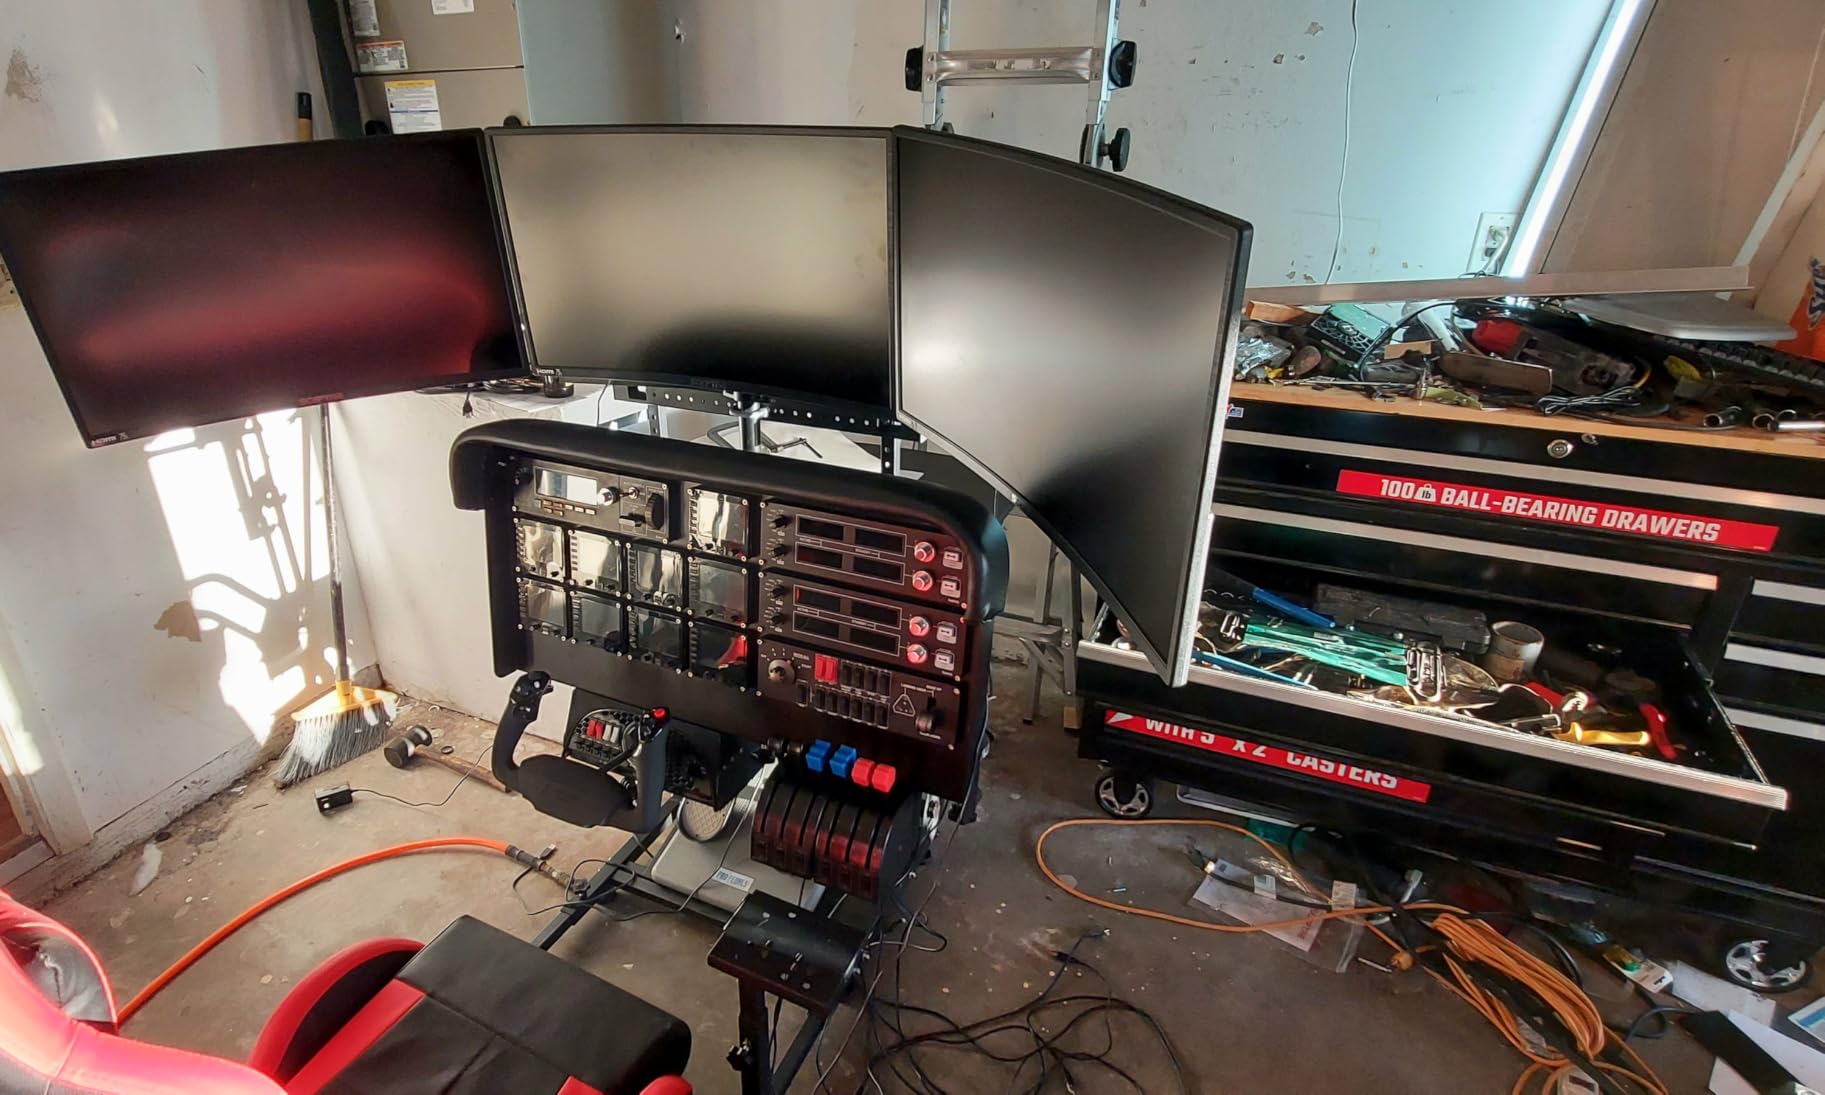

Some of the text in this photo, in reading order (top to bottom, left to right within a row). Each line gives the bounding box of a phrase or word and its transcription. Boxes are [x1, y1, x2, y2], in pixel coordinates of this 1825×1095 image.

[1380, 479, 1721, 542] 100 lb BALL-BEARING DRAWERS
